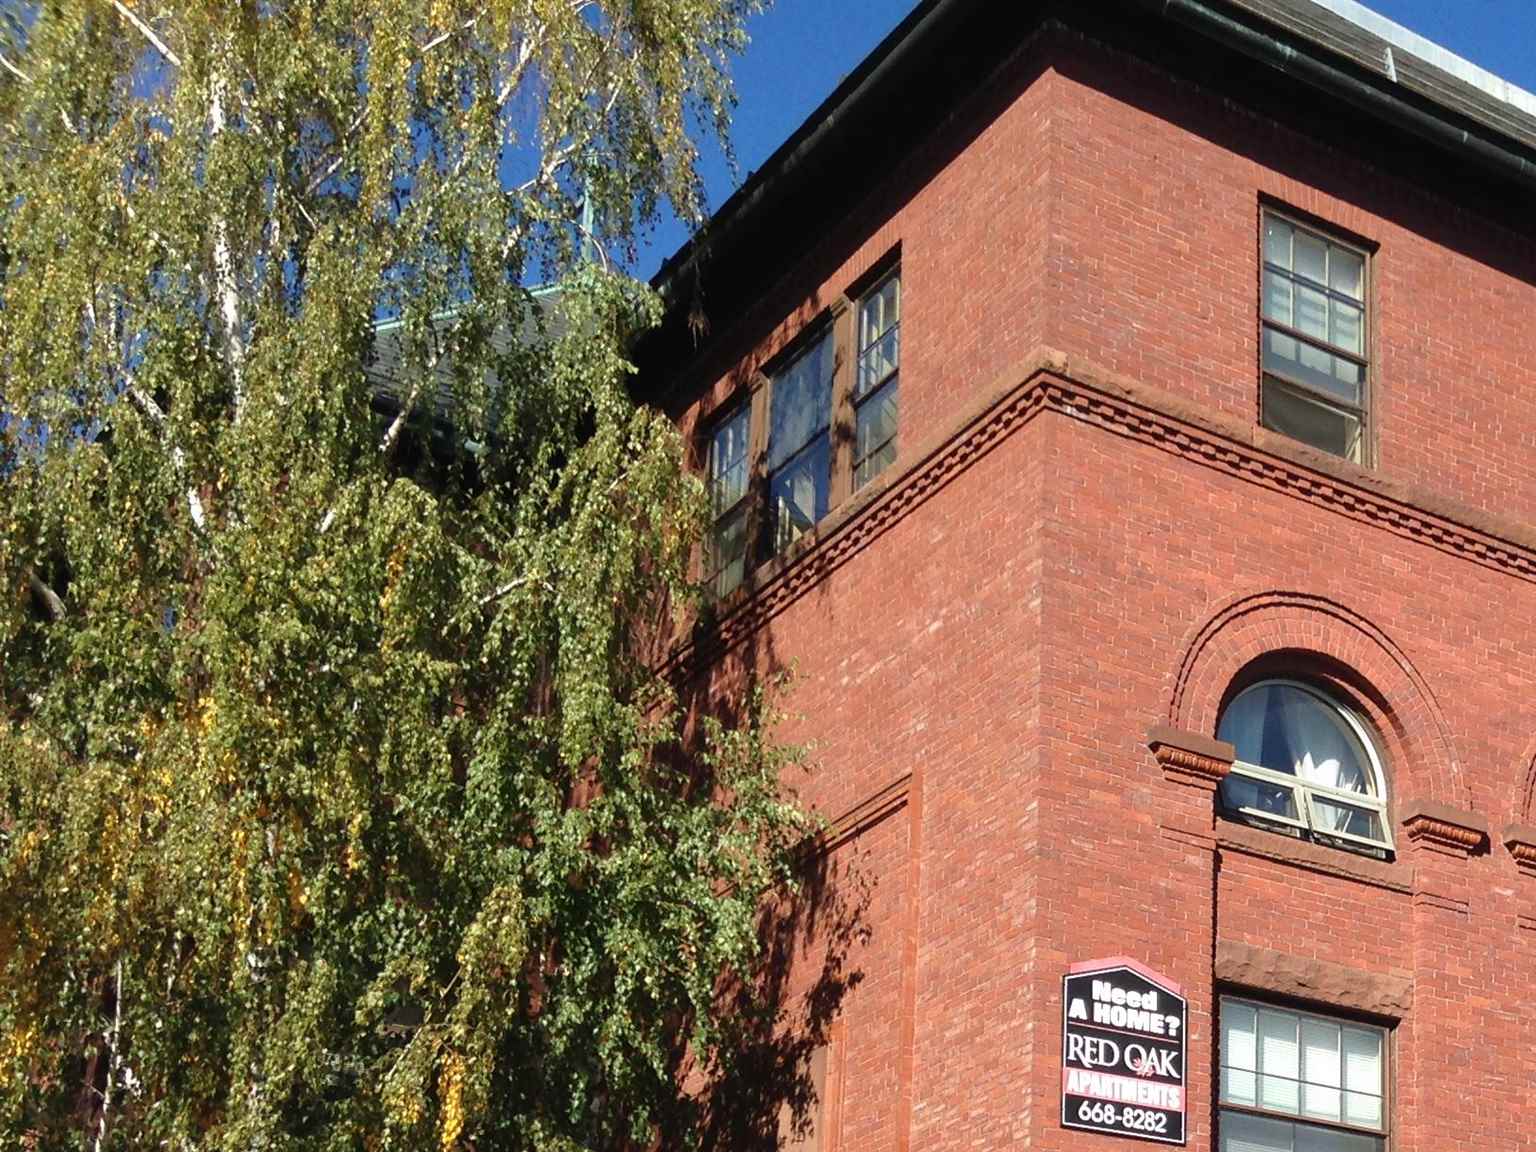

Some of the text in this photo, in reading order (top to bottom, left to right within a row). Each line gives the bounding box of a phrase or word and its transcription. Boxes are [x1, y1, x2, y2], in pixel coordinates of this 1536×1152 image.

[1092, 980, 1158, 1011] Need
[1068, 998, 1181, 1037] A HOME?
[1067, 1033, 1181, 1079] RED OAK
[1067, 1070, 1180, 1109] APARTMENTS
[1078, 1100, 1168, 1133] 668-8282
